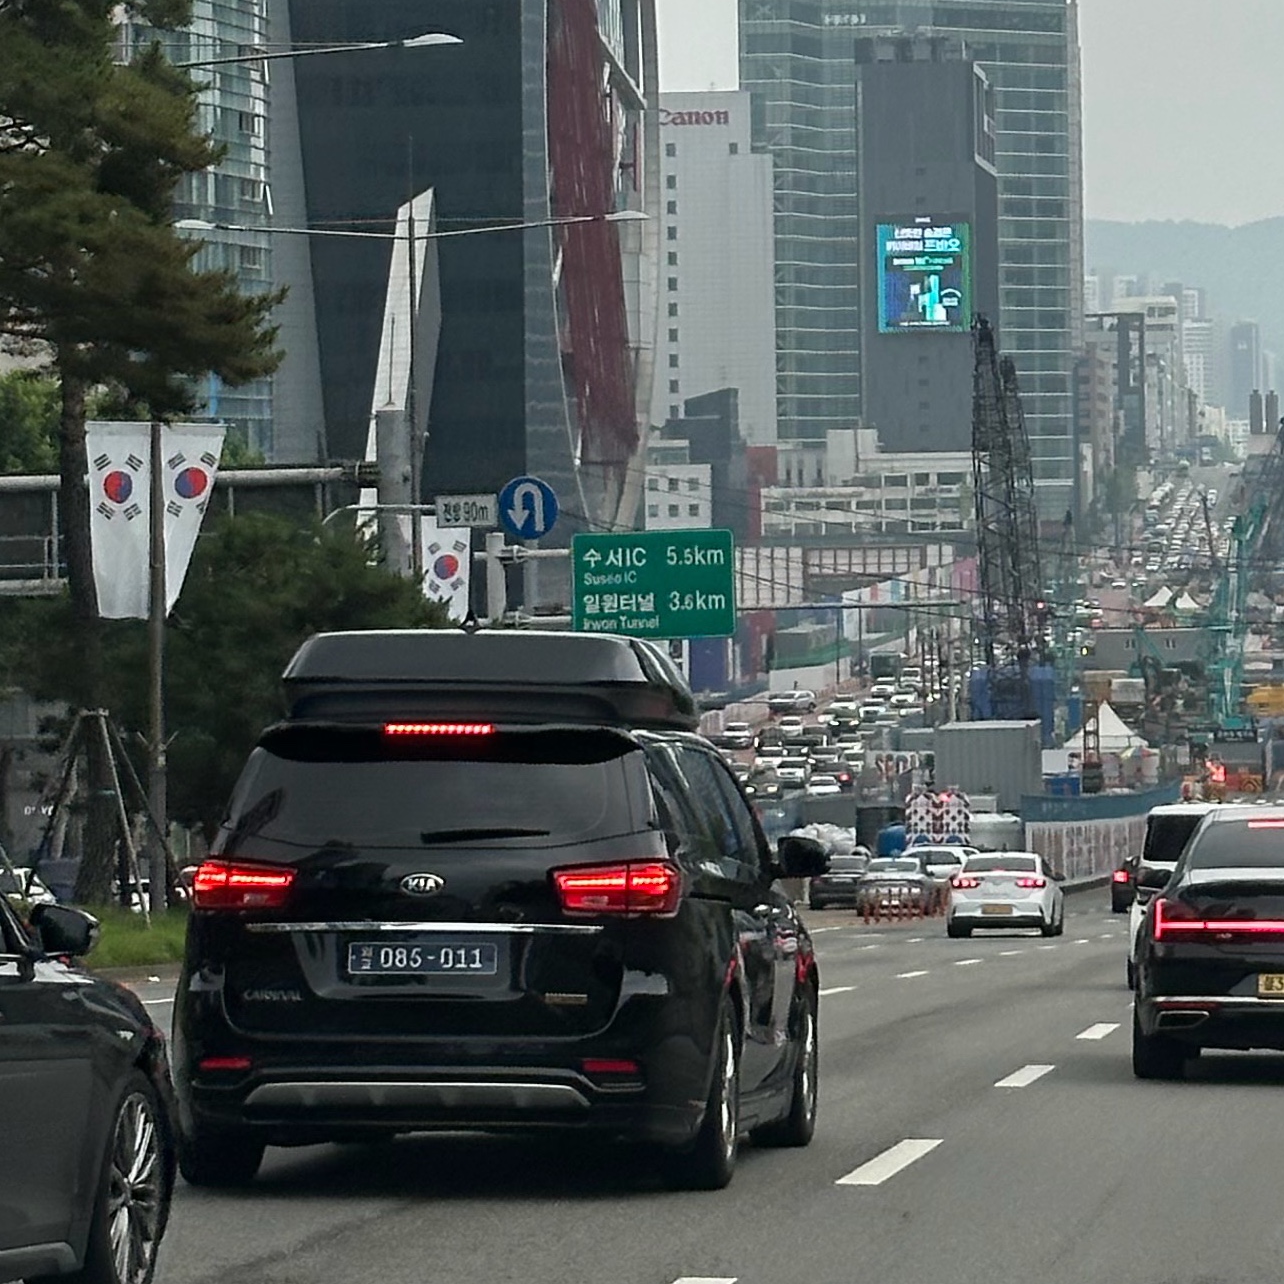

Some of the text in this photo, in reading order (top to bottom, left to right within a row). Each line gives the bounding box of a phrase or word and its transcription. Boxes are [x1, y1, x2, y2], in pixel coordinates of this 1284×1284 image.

[659, 109, 730, 126] Canon
[464, 501, 489, 522] 90m
[583, 546, 724, 568] 수서IC 5.5km
[584, 570, 637, 586] Suseo IC
[583, 590, 726, 614] 일원터널 3.6km
[619, 615, 659, 629] Tunnel
[406, 877, 438, 892] KIA
[379, 947, 483, 969] 085-011
